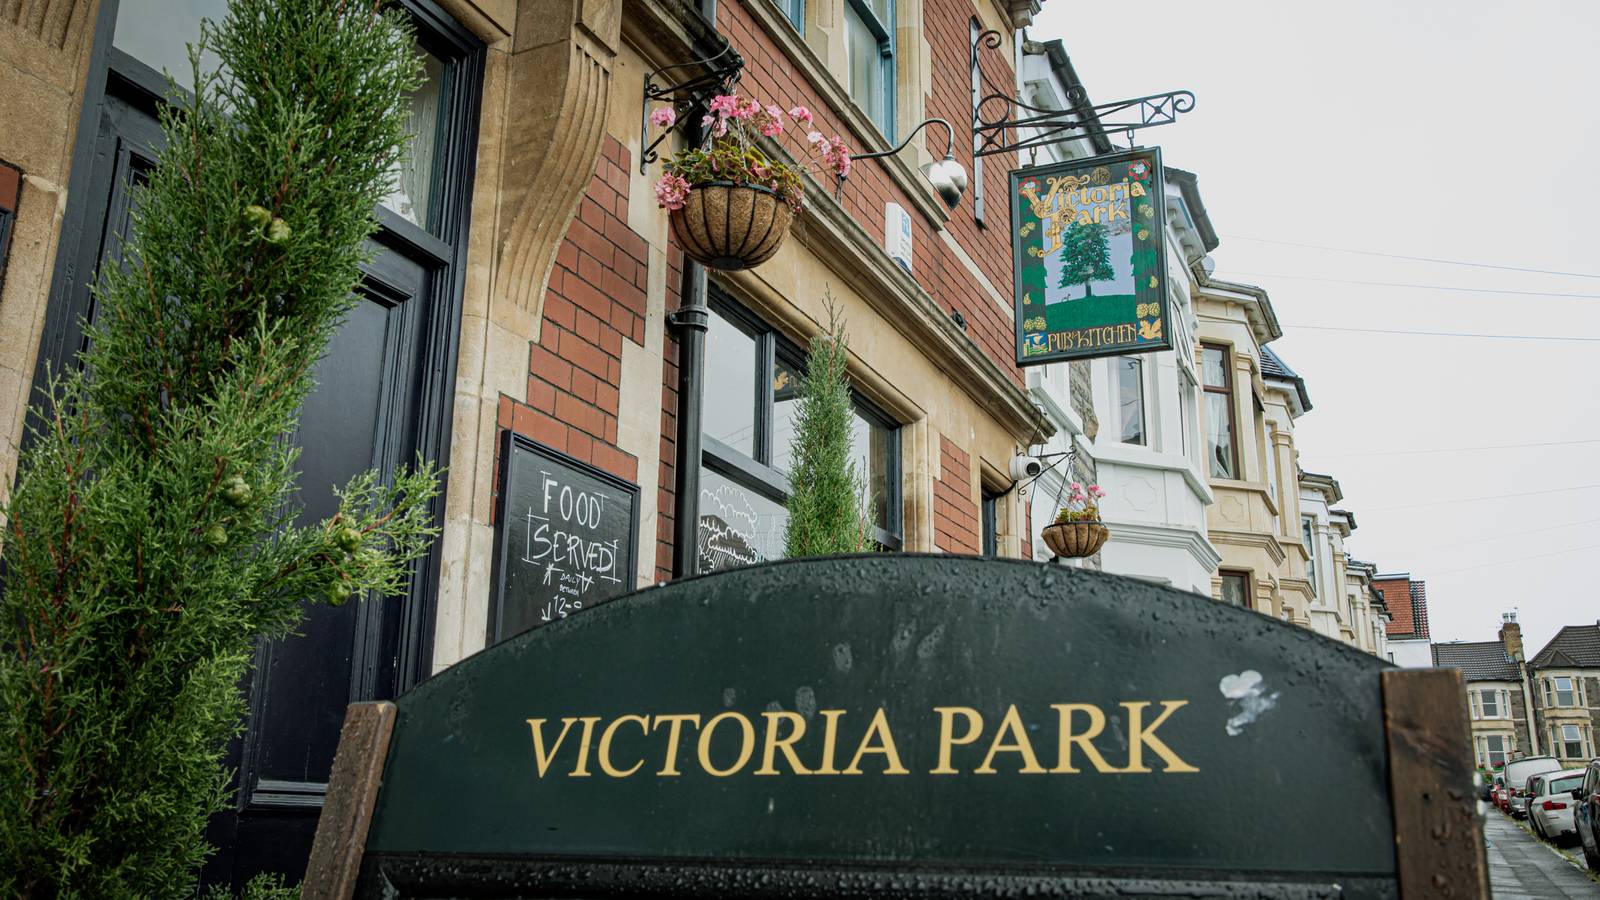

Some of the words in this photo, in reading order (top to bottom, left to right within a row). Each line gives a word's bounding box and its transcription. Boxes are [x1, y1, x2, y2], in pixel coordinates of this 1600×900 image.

[1022, 174, 1147, 219] Victoria
[1037, 200, 1130, 257] Park
[1047, 331, 1074, 352] PUB
[1076, 323, 1137, 349] KITCHEN
[544, 478, 601, 530] FOOD
[532, 523, 614, 573] SERVED
[525, 707, 909, 778] VICTORIA
[929, 700, 1200, 774] PARK
